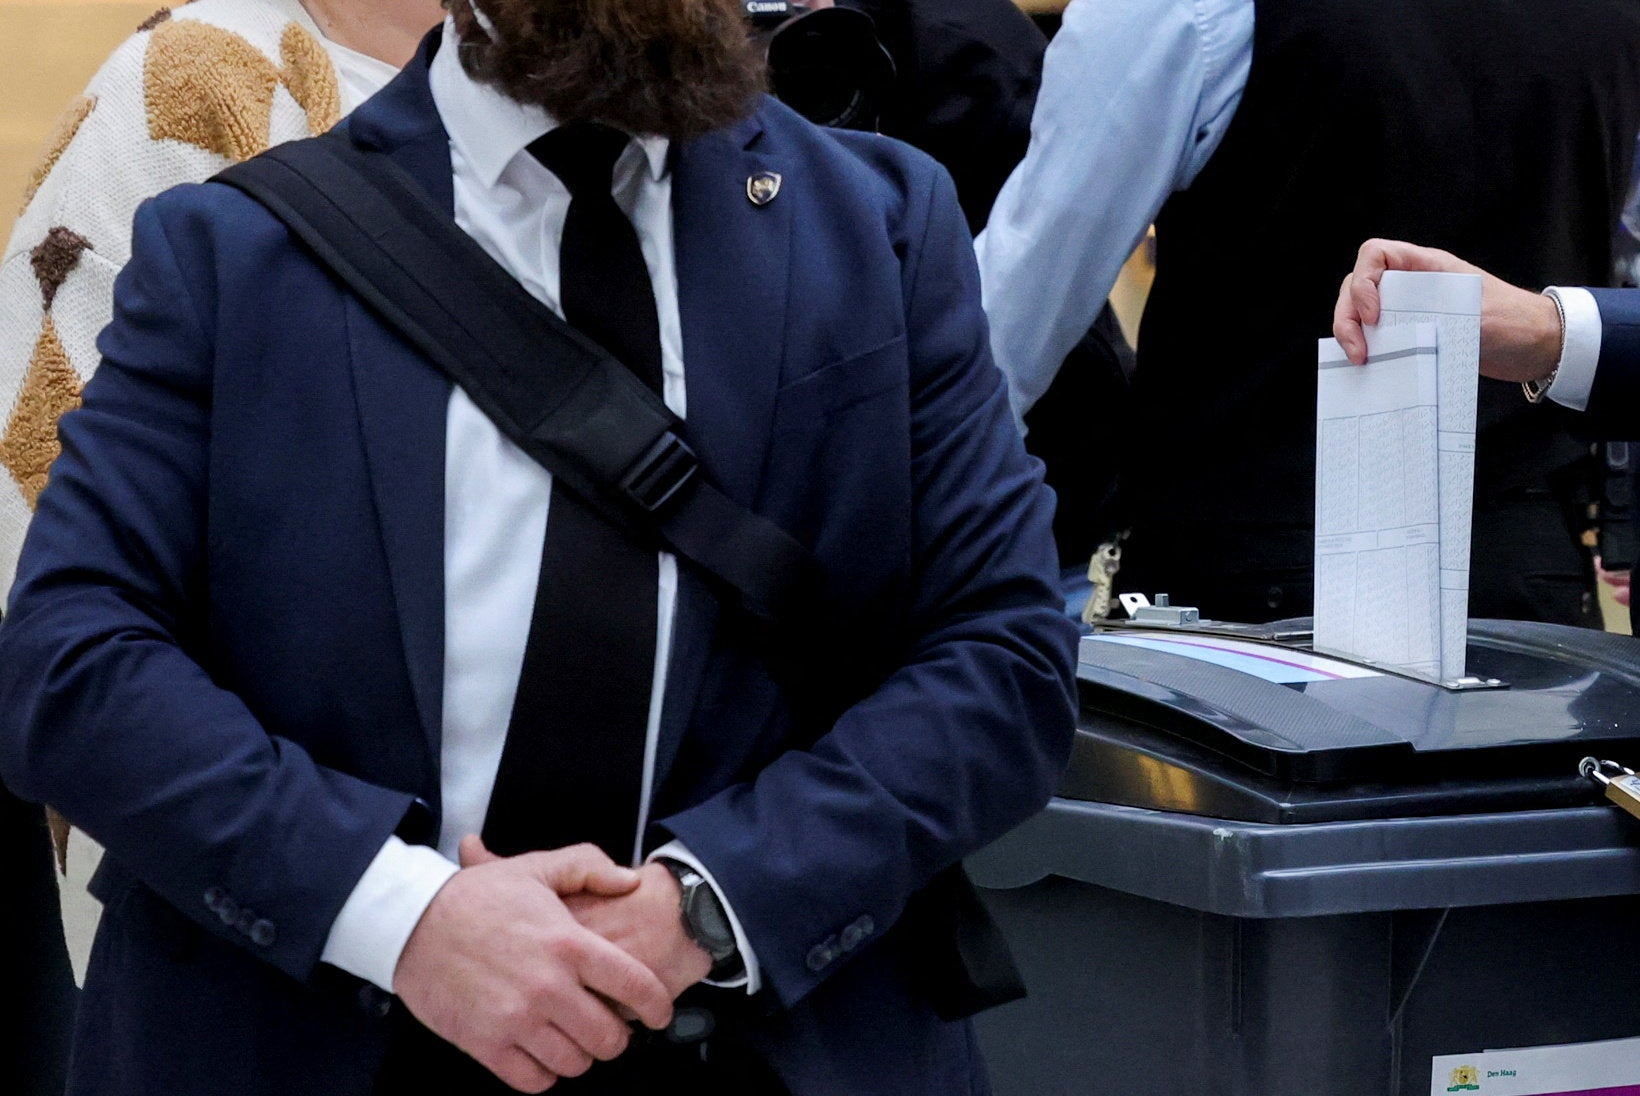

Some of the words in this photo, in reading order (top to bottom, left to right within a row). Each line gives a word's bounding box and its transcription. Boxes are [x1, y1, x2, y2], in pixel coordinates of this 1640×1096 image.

[747, 1, 787, 12] Canon
[1487, 1070, 1499, 1078] Den
[1500, 1068, 1517, 1077] Haag
